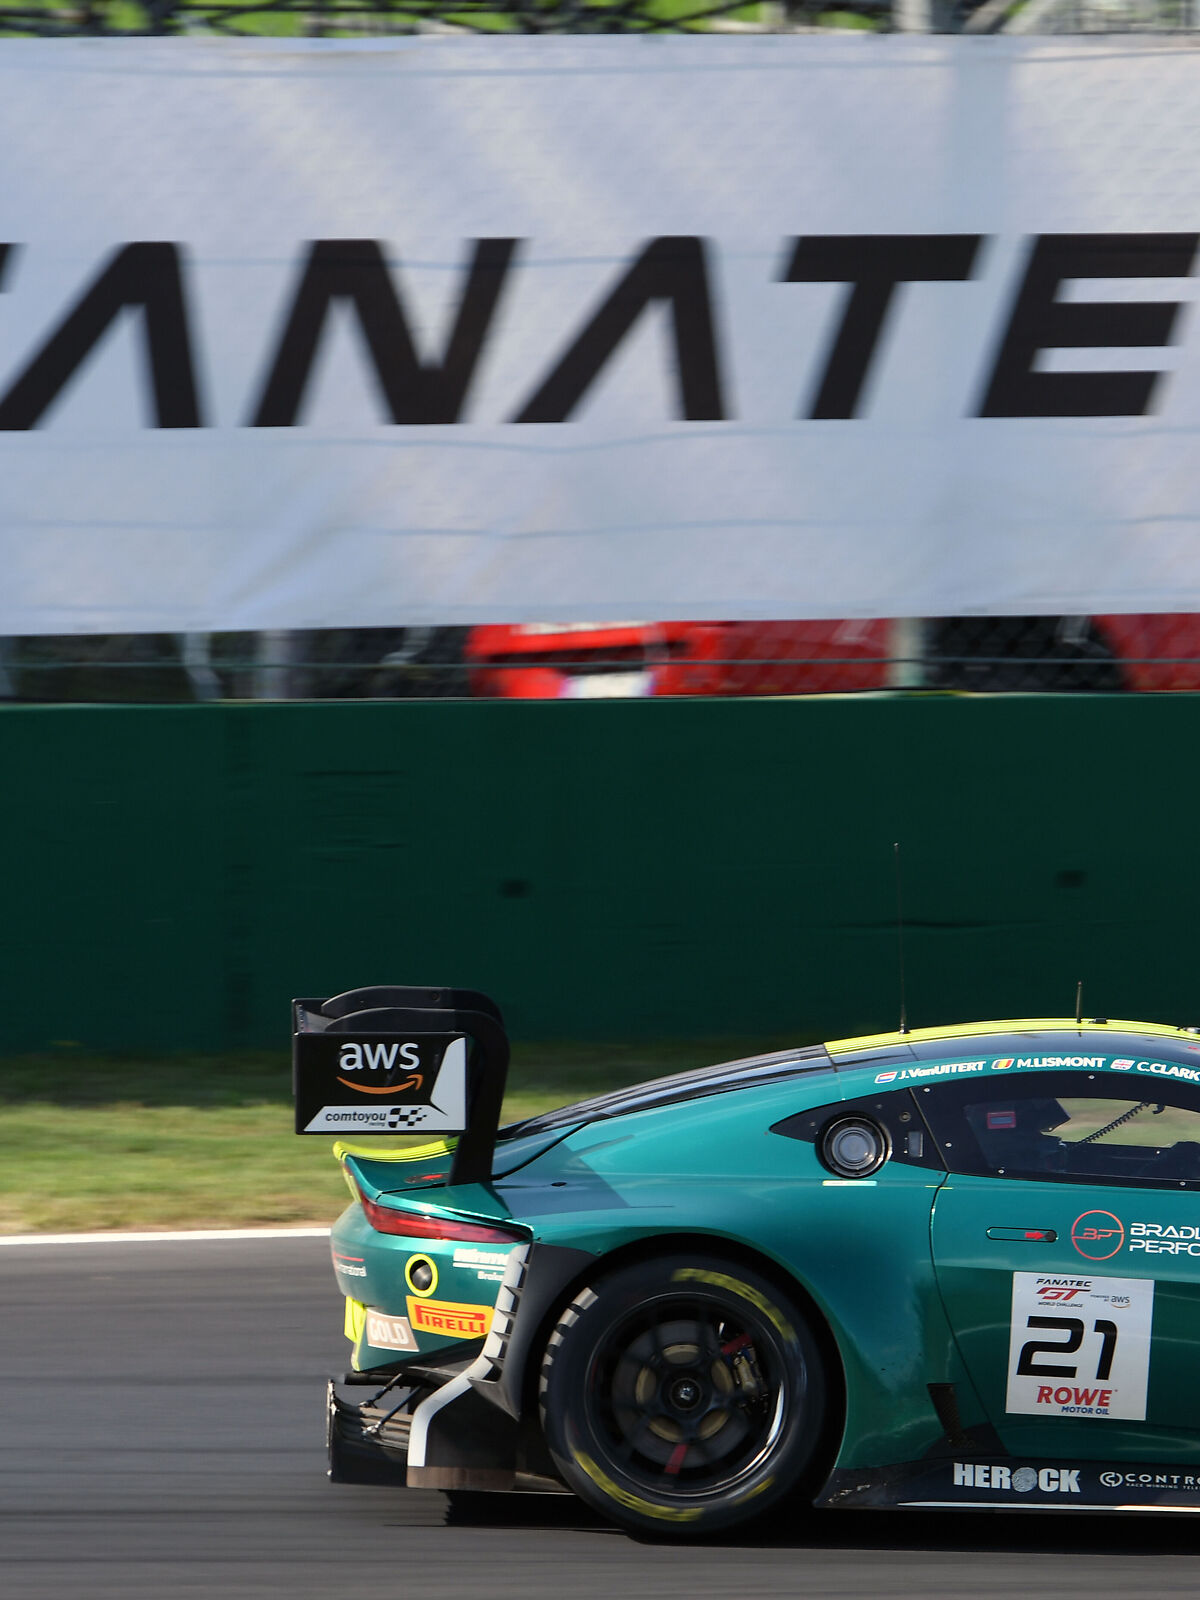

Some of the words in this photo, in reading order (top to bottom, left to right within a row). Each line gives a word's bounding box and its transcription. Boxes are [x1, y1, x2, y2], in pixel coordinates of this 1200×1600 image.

[339, 1042, 420, 1071] aws
[325, 1111, 387, 1124] comtoyou
[1036, 1279, 1092, 1287] FANATEC
[1111, 1296, 1130, 1304] aws
[369, 1317, 410, 1345] GOLD
[414, 1304, 486, 1334] PIRELLI
[1017, 1316, 1117, 1380] 21
[1037, 1385, 1113, 1407] ROWE
[1061, 1406, 1093, 1415] MOTOR
[1096, 1408, 1110, 1416] OIL
[953, 1462, 1081, 1493] HEROCK
